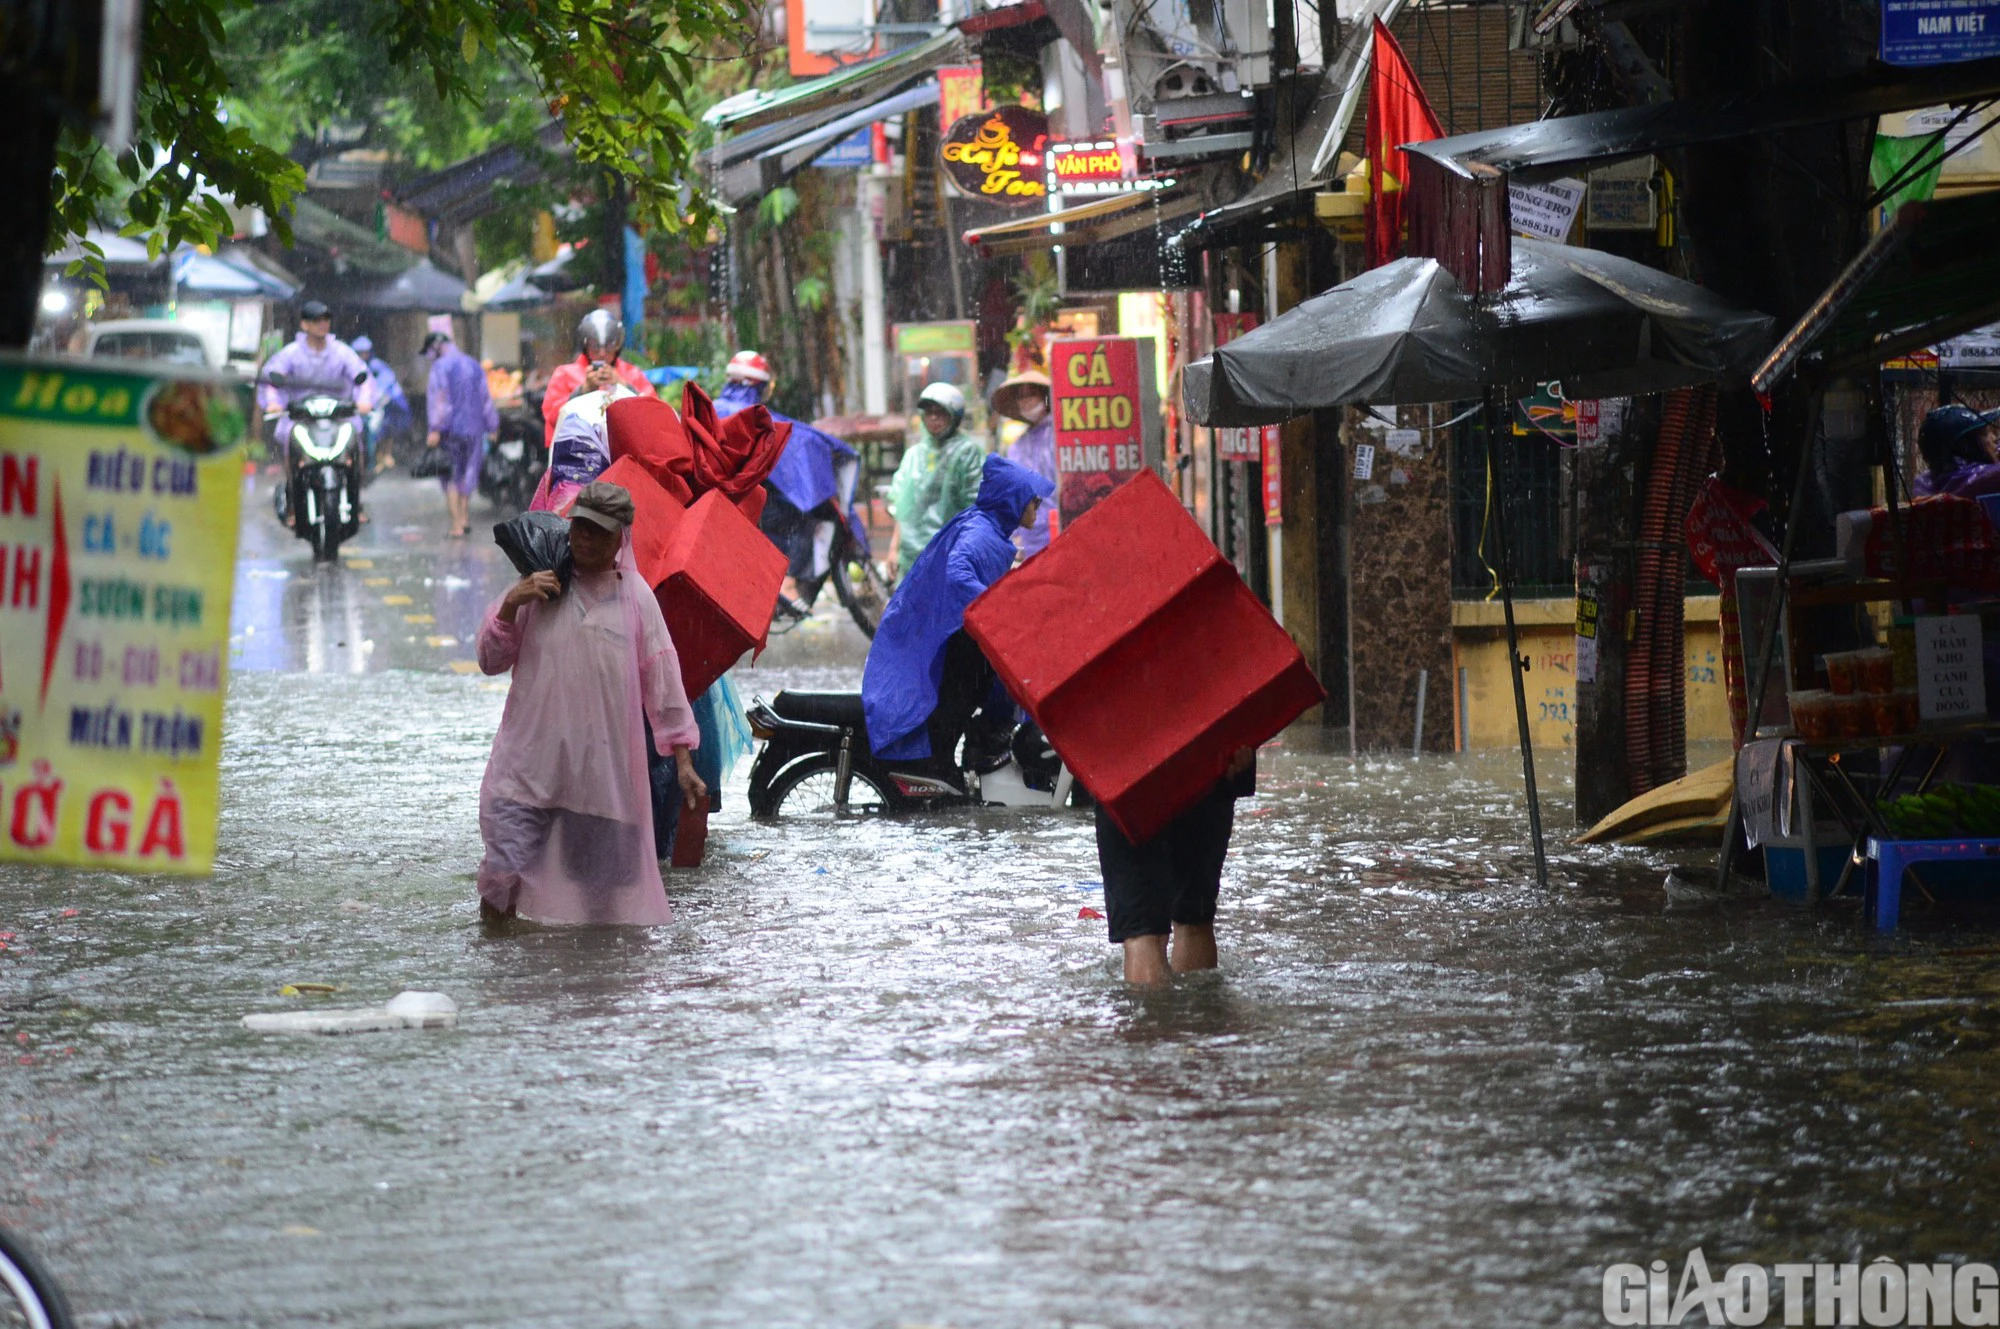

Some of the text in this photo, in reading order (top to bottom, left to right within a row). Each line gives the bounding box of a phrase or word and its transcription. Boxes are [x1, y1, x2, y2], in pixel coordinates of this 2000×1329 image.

[1918, 12, 1986, 36] NAM VIỆT
[1055, 153, 1087, 175] VĂN
[1089, 151, 1122, 173] PHÒ
[1509, 188, 1542, 208] HÒNG
[1545, 199, 1571, 217] TRỌ
[1067, 343, 1112, 388] CÁ
[15, 371, 130, 418] Hoa
[1061, 395, 1132, 431] KHO
[1059, 437, 1109, 472] HÀNG
[152, 457, 197, 497] CUA
[84, 514, 171, 560] CÁ ỐC
[80, 576, 145, 620] SƯỜN
[1939, 621, 1956, 634] CÁ
[1937, 653, 1963, 664] KHO
[1934, 671, 1968, 682] CANH
[1939, 686, 1964, 697] CUA
[70, 700, 131, 750] MIẾN
[140, 705, 203, 761] TRỘN
[908, 784, 945, 794] BOSS
[85, 778, 187, 862] GÀ
